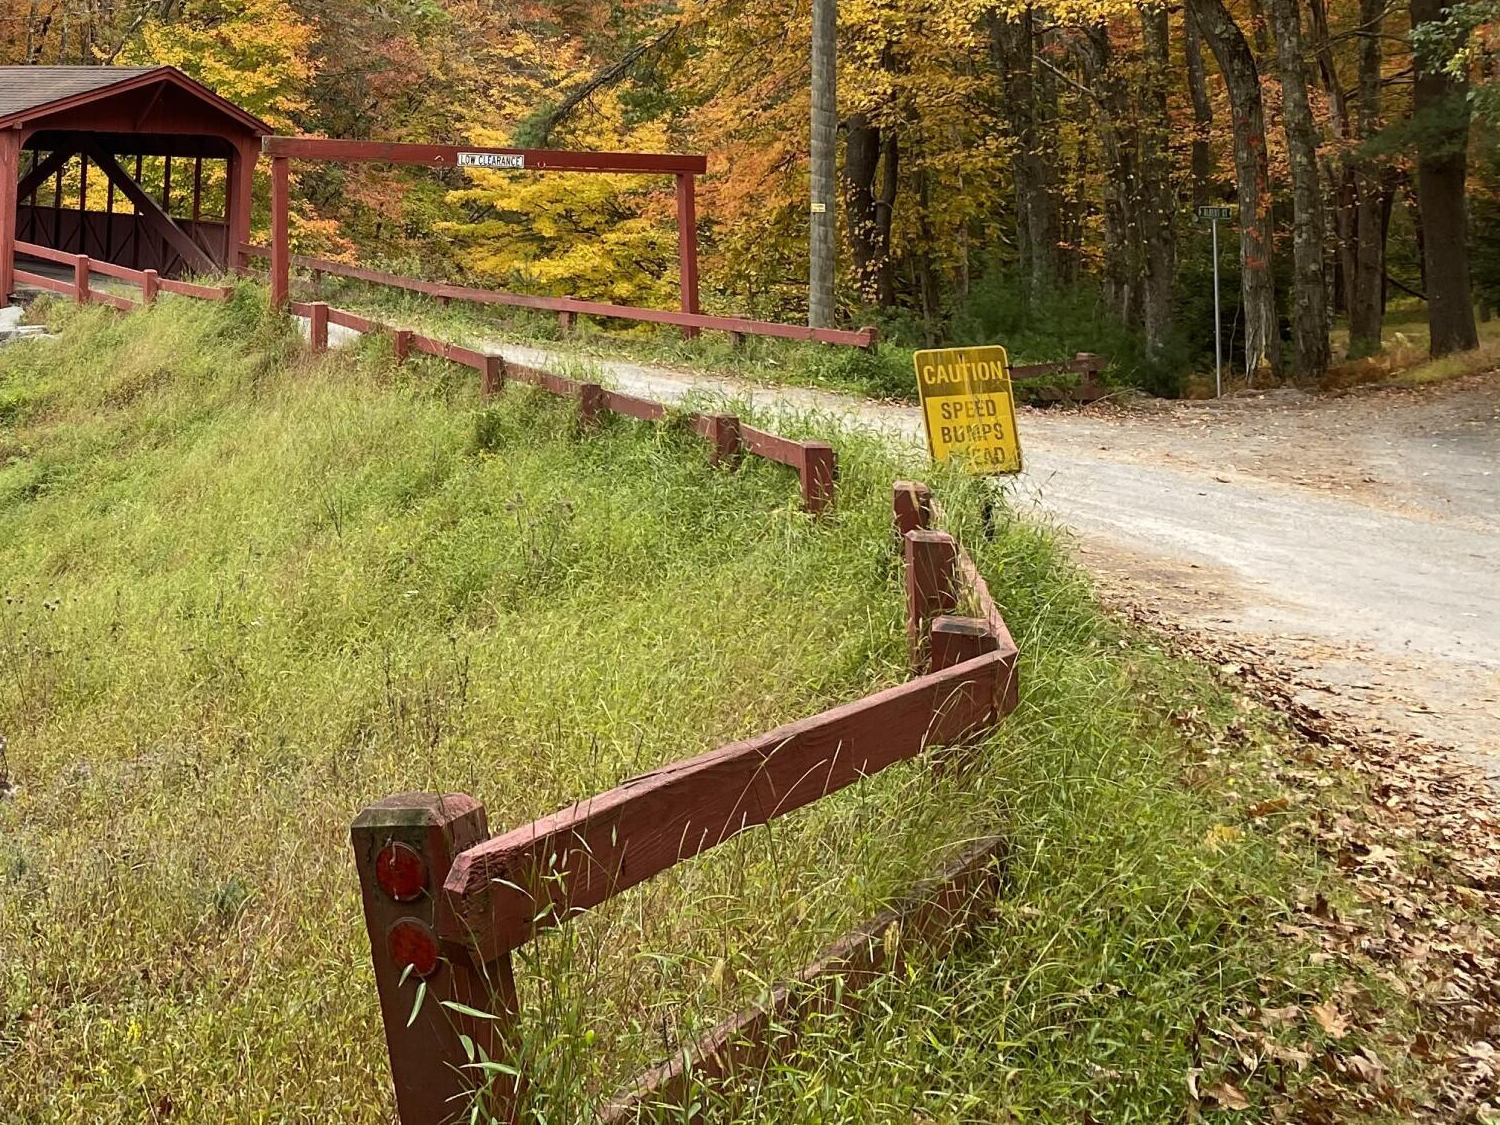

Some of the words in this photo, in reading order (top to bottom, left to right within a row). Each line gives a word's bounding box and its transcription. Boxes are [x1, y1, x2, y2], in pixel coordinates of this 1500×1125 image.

[461, 154, 476, 165] LOW
[478, 155, 520, 167] CLEARANCE
[923, 360, 1003, 385] CAUTION
[941, 399, 997, 420] SPEED
[941, 422, 1005, 444] BUMPS
